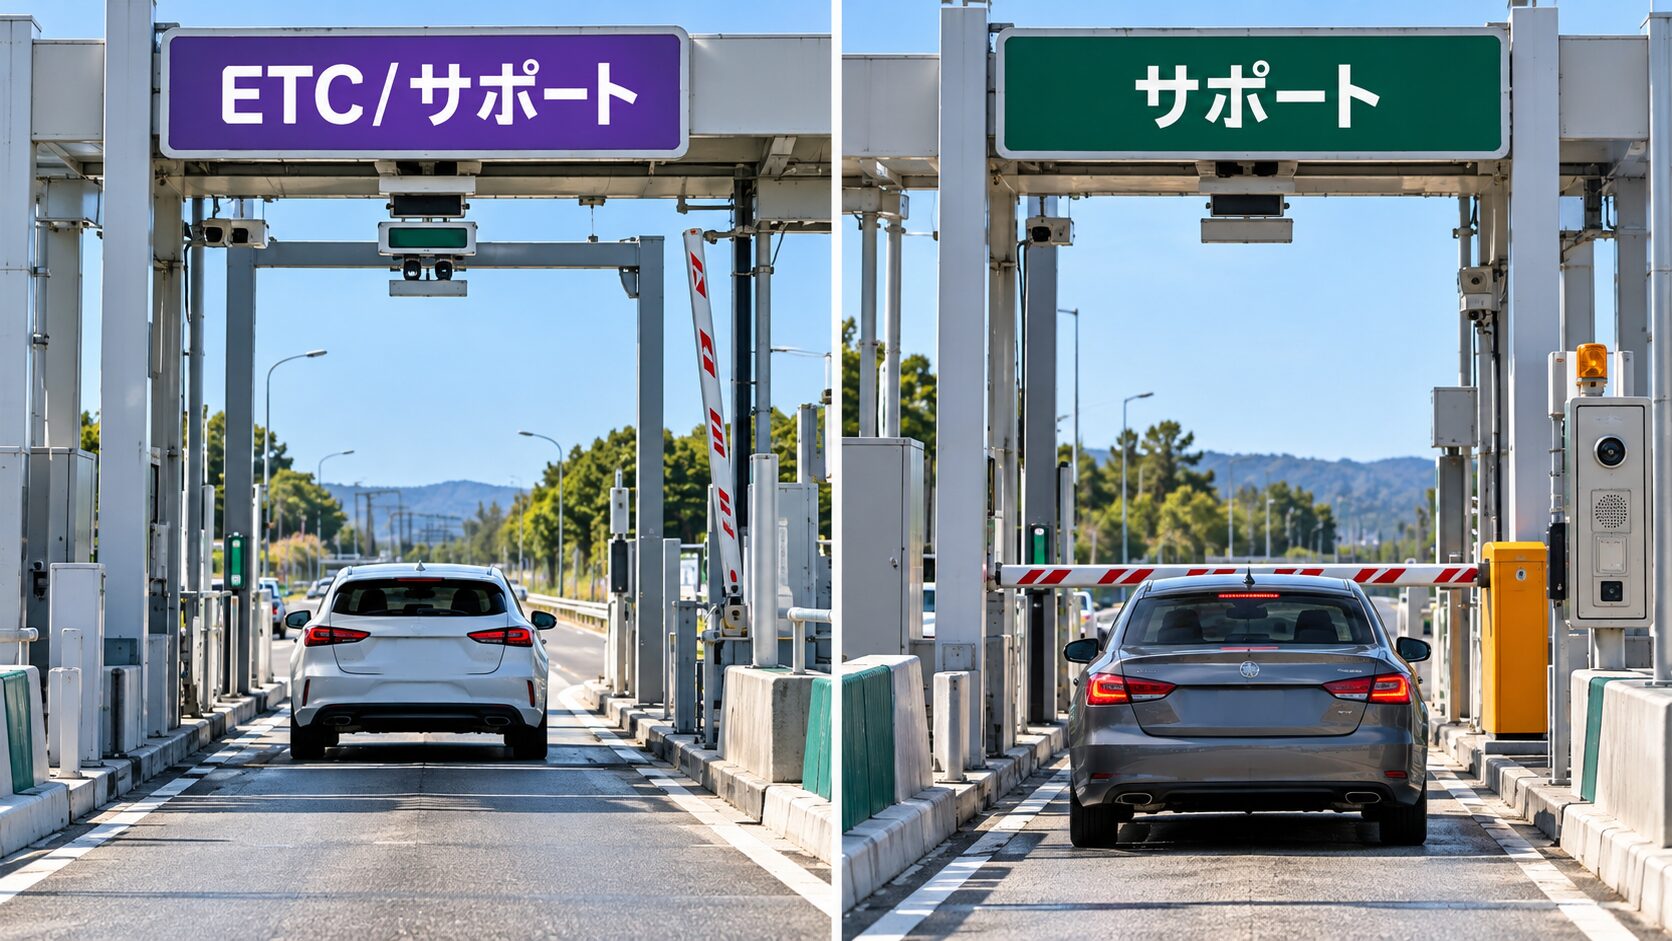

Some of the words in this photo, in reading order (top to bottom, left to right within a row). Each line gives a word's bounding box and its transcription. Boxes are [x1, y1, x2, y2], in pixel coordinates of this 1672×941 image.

[221, 58, 638, 127] ETC/サポート
[1135, 60, 1380, 129] サポート
